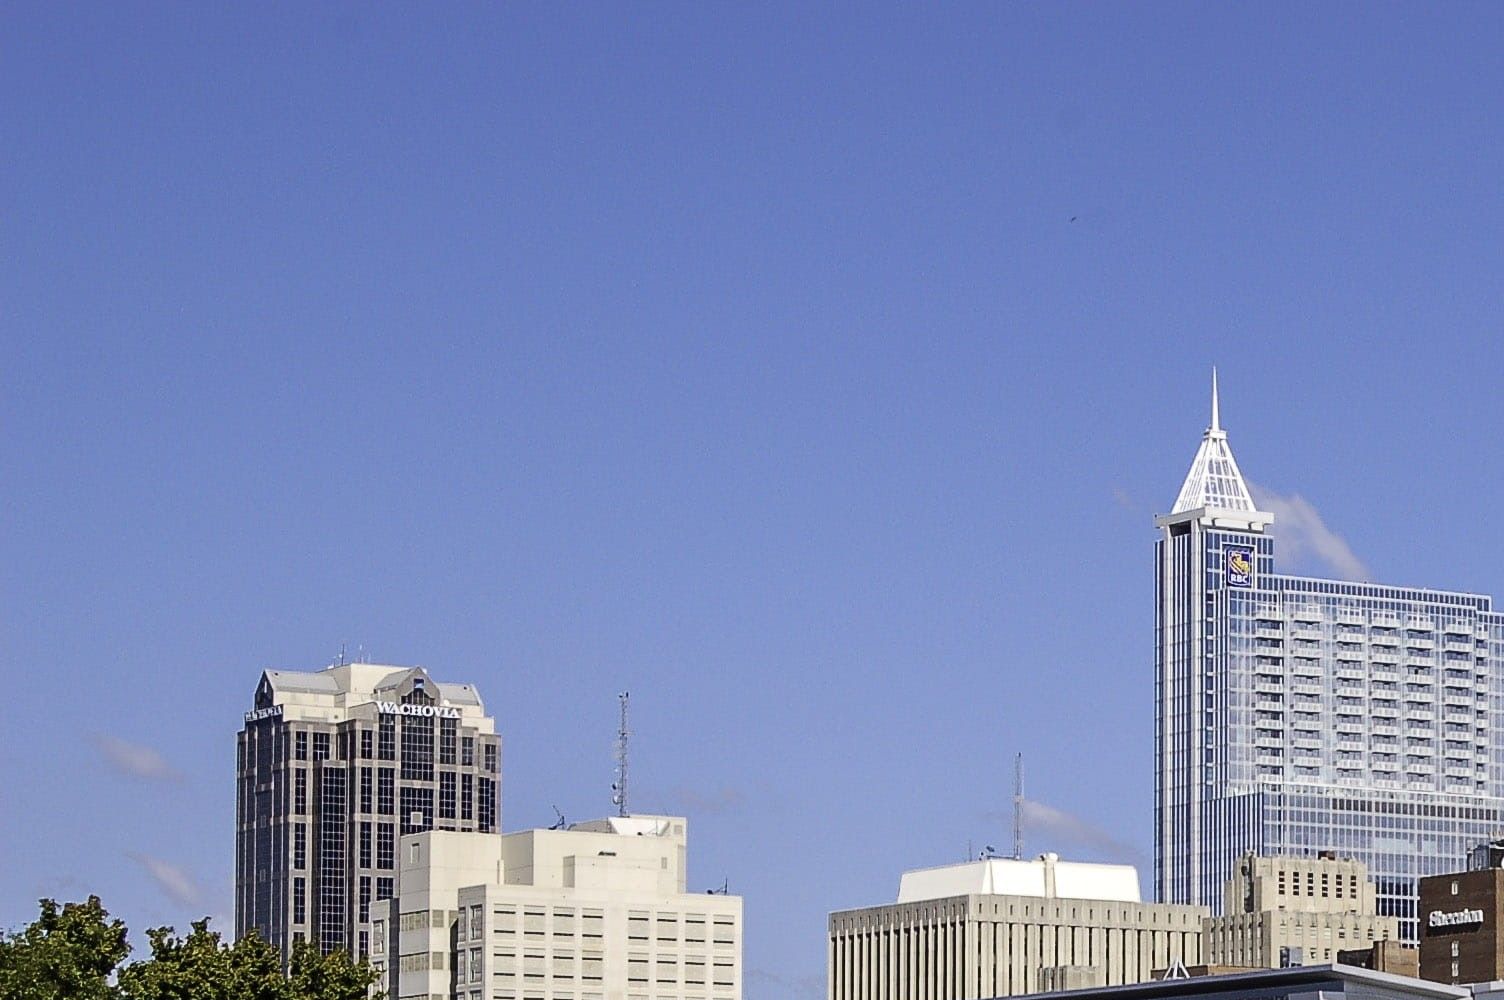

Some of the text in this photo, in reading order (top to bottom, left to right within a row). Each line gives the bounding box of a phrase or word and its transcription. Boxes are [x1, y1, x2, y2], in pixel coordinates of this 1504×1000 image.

[1230, 573, 1248, 584] RBC
[377, 700, 462, 719] WACHOVIA
[1429, 908, 1484, 927] Sheraton
